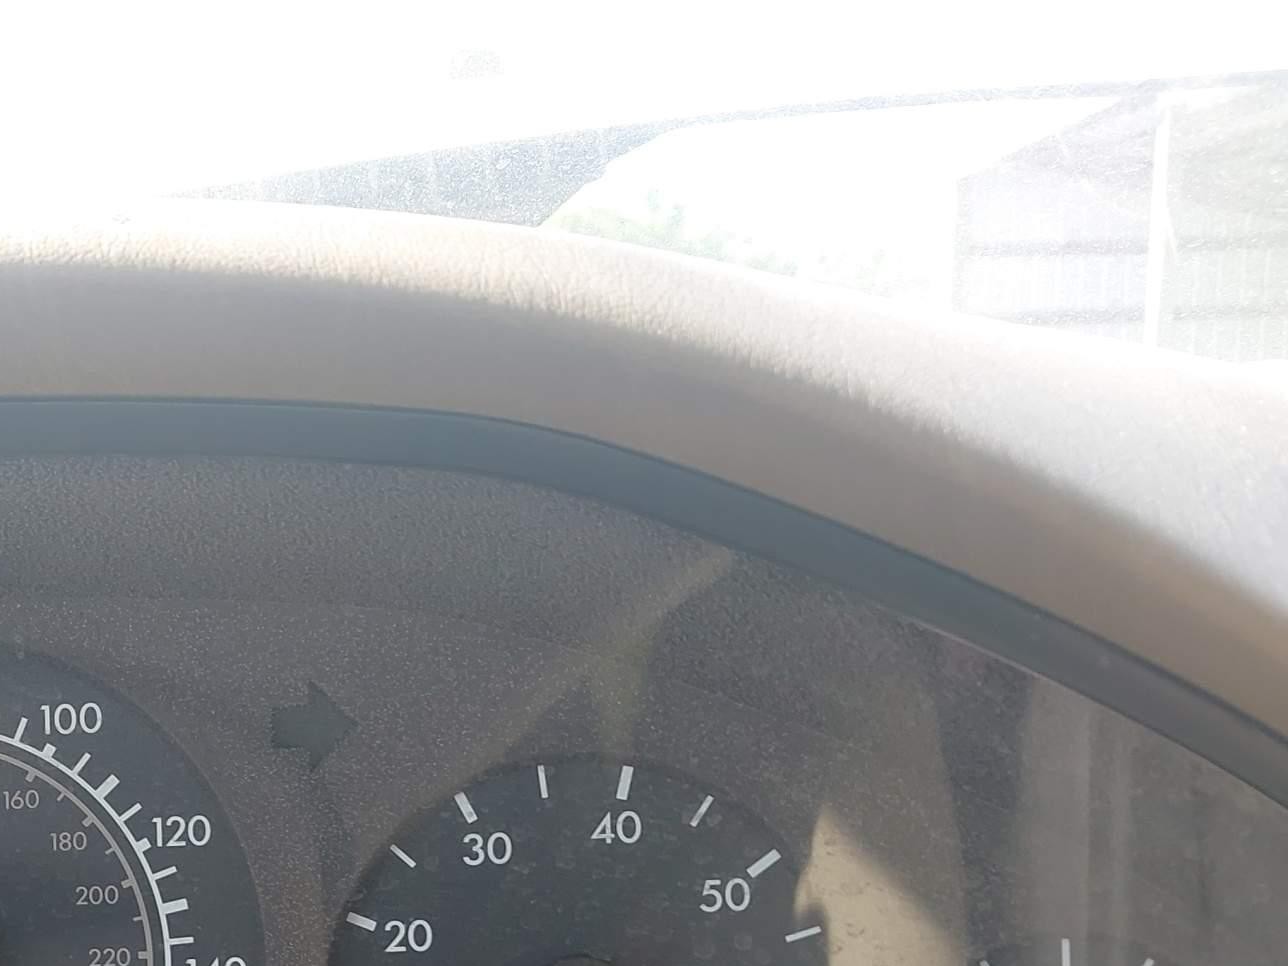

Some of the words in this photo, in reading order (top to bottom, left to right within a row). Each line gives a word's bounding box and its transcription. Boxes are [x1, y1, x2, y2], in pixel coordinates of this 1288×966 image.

[41, 703, 102, 734] 100
[2, 790, 40, 810] 160
[50, 832, 88, 852] 180
[151, 815, 211, 847] 120
[591, 810, 642, 844] 40
[462, 832, 512, 866] 30
[75, 885, 119, 905] 200
[699, 878, 751, 913] 50
[384, 919, 433, 953] 20
